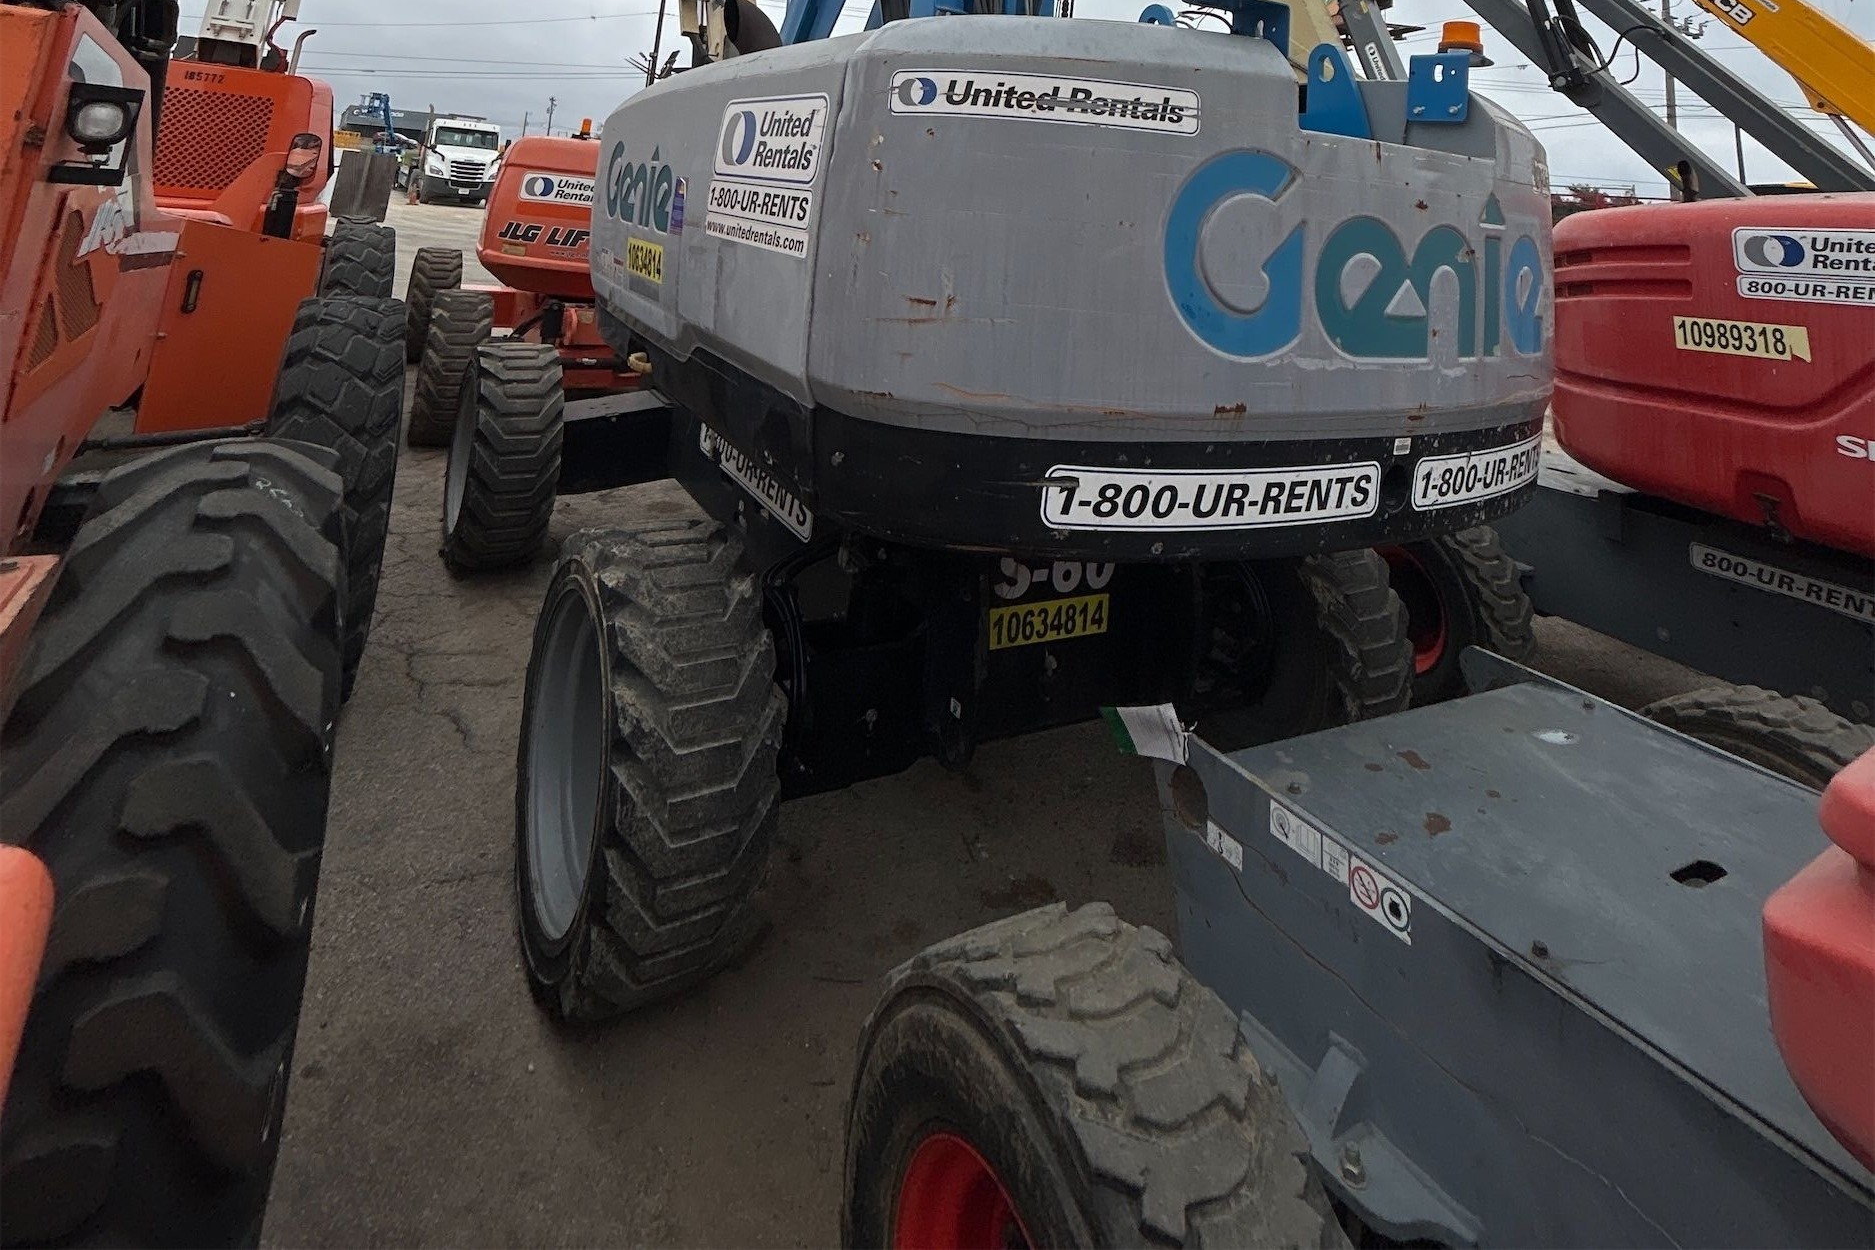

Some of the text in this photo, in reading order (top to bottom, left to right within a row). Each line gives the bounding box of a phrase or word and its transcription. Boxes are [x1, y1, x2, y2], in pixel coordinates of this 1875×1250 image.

[945, 79, 1060, 112] United
[759, 108, 816, 138] United
[752, 140, 814, 171] Rentals
[607, 140, 673, 236] Genie
[709, 185, 810, 222] 1-800-UR-RENTS
[498, 221, 545, 245] JLG
[706, 220, 805, 253] www.unitedrentals.com
[627, 242, 663, 281] 10634814
[1163, 148, 1544, 364] Genie
[1677, 319, 1787, 356] 10989318
[1057, 473, 1373, 520] 1-800-UR-RENTS
[992, 600, 1105, 646] 10634814
